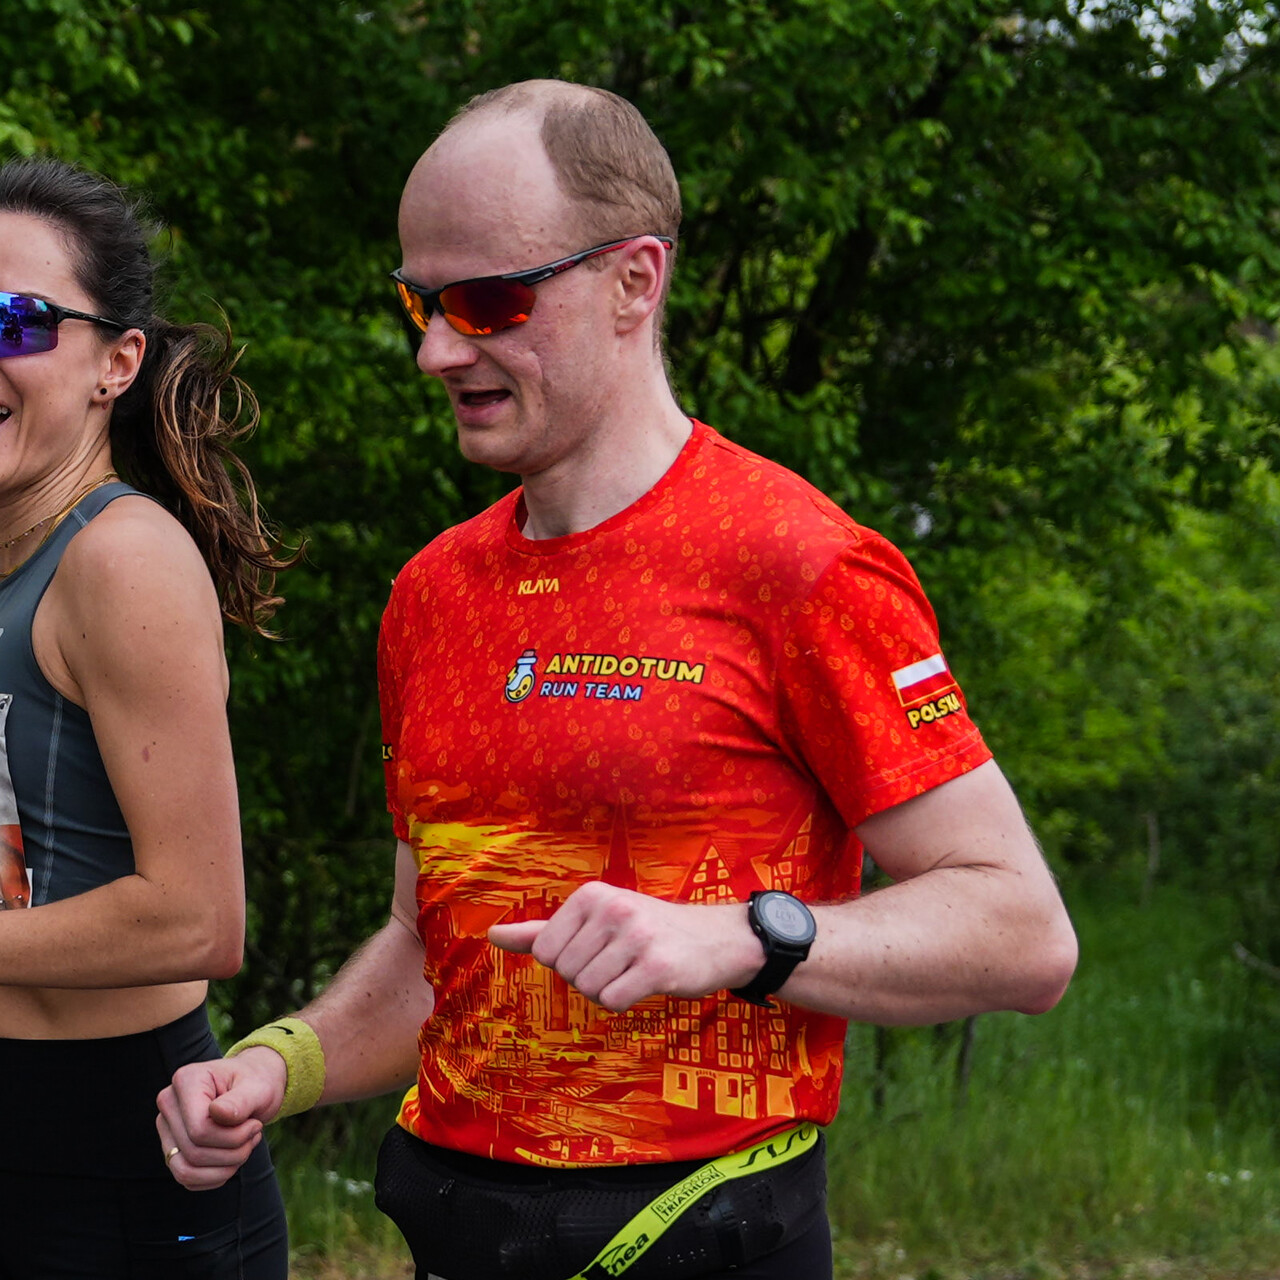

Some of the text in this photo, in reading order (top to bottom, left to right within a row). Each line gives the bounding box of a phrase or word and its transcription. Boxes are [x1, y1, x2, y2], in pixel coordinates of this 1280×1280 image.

[544, 653, 706, 685] ANTIDOTUM
[539, 681, 642, 700] RUN TEAM
[661, 1173, 721, 1216] TRIATHLON
